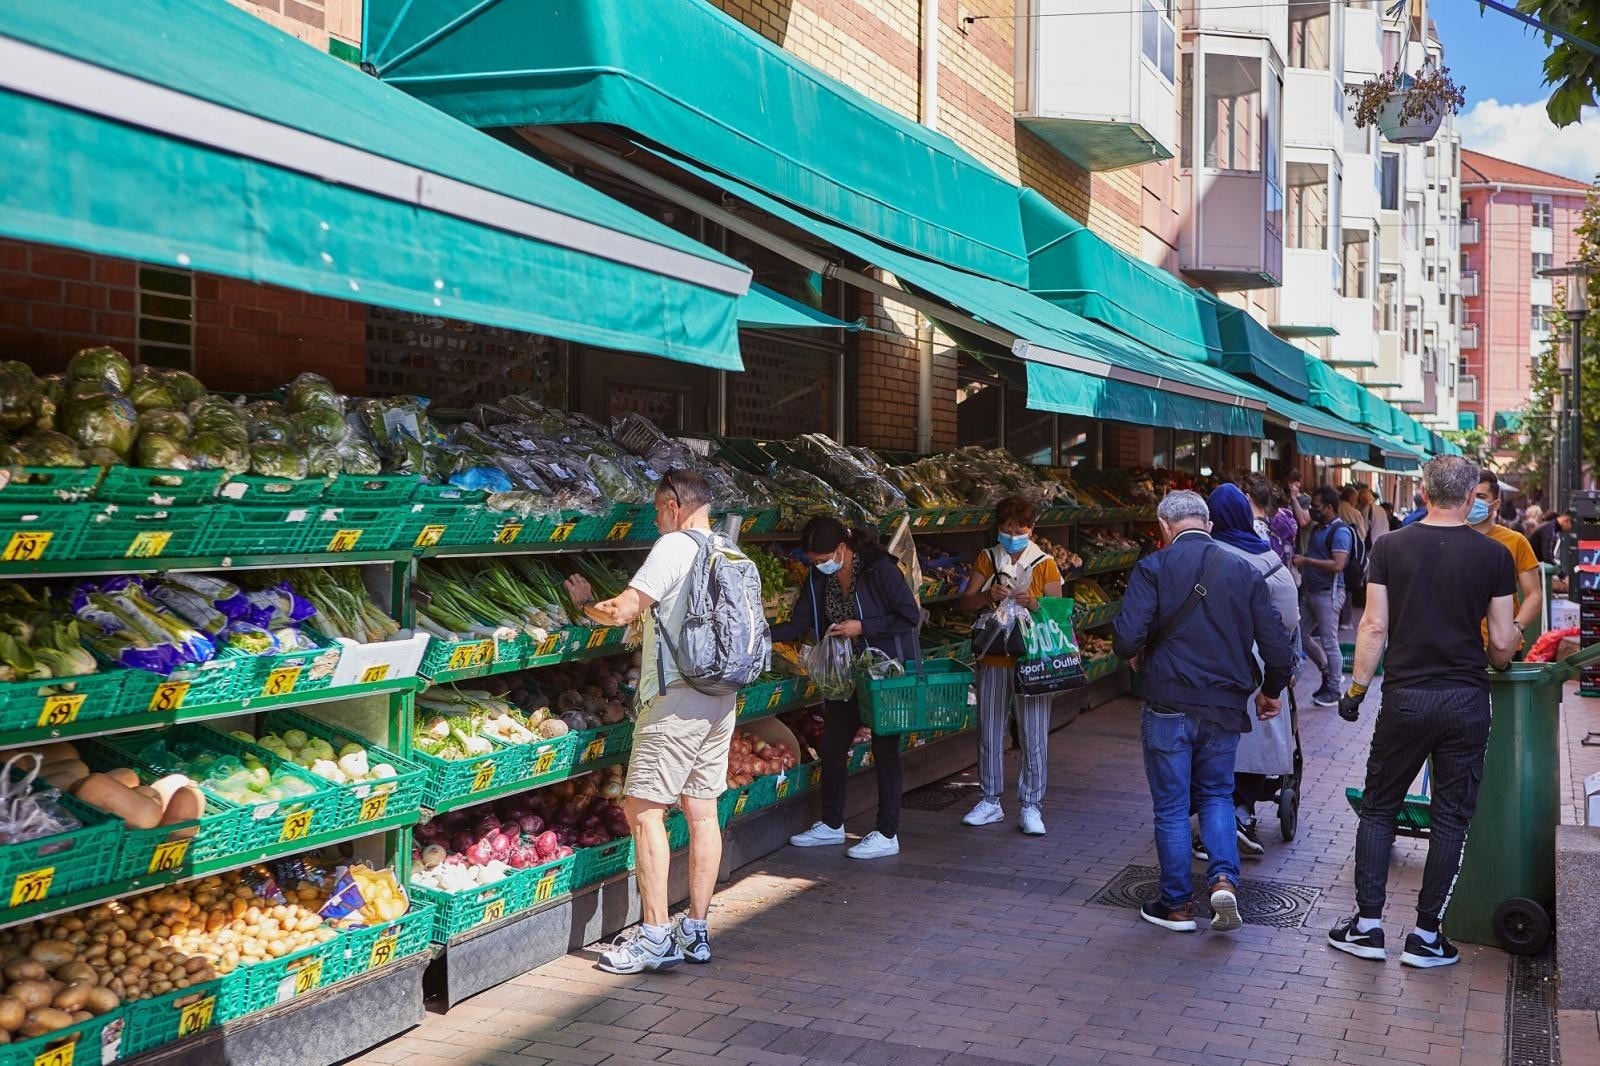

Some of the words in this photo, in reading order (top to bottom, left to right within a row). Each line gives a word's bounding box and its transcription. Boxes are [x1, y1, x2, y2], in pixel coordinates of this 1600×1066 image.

[1020, 661, 1045, 675] Sport
[1053, 656, 1081, 669] Outlet
[156, 687, 175, 711] 8
